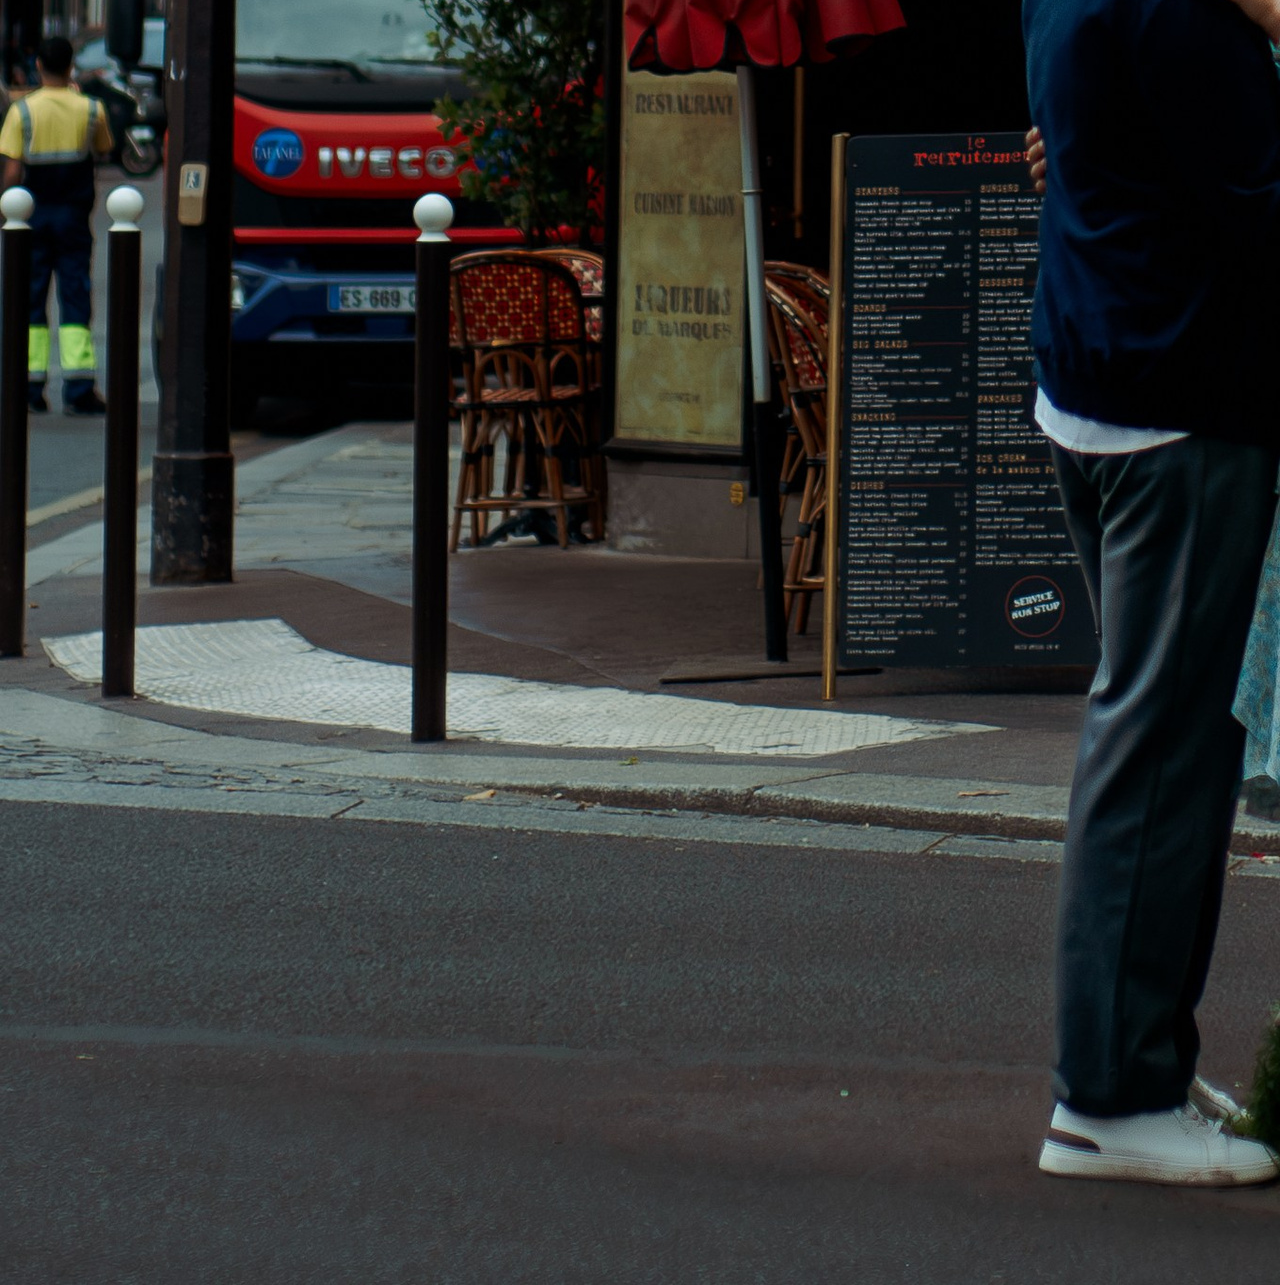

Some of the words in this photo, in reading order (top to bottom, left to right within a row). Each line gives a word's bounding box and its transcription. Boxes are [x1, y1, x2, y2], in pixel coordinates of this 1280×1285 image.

[635, 93, 733, 116] RESTAURANT
[967, 136, 986, 150] le
[317, 145, 457, 180] IVECO
[913, 149, 1031, 167] recrutemen
[855, 186, 900, 196] STARTERS
[980, 184, 1019, 193] BURGERS
[979, 227, 1019, 237] CHEESES
[979, 278, 1024, 288] DESSERTS
[853, 304, 887, 313] BOARDS
[853, 340, 870, 349] BIG
[874, 339, 909, 349] SALADS
[977, 393, 1022, 404] PANCAKES
[851, 413, 896, 421] SNACKING
[976, 454, 993, 463] ICE
[850, 482, 885, 490] DISHES
[1014, 590, 1054, 608] SERVICE
[1033, 601, 1061, 615] STOP
